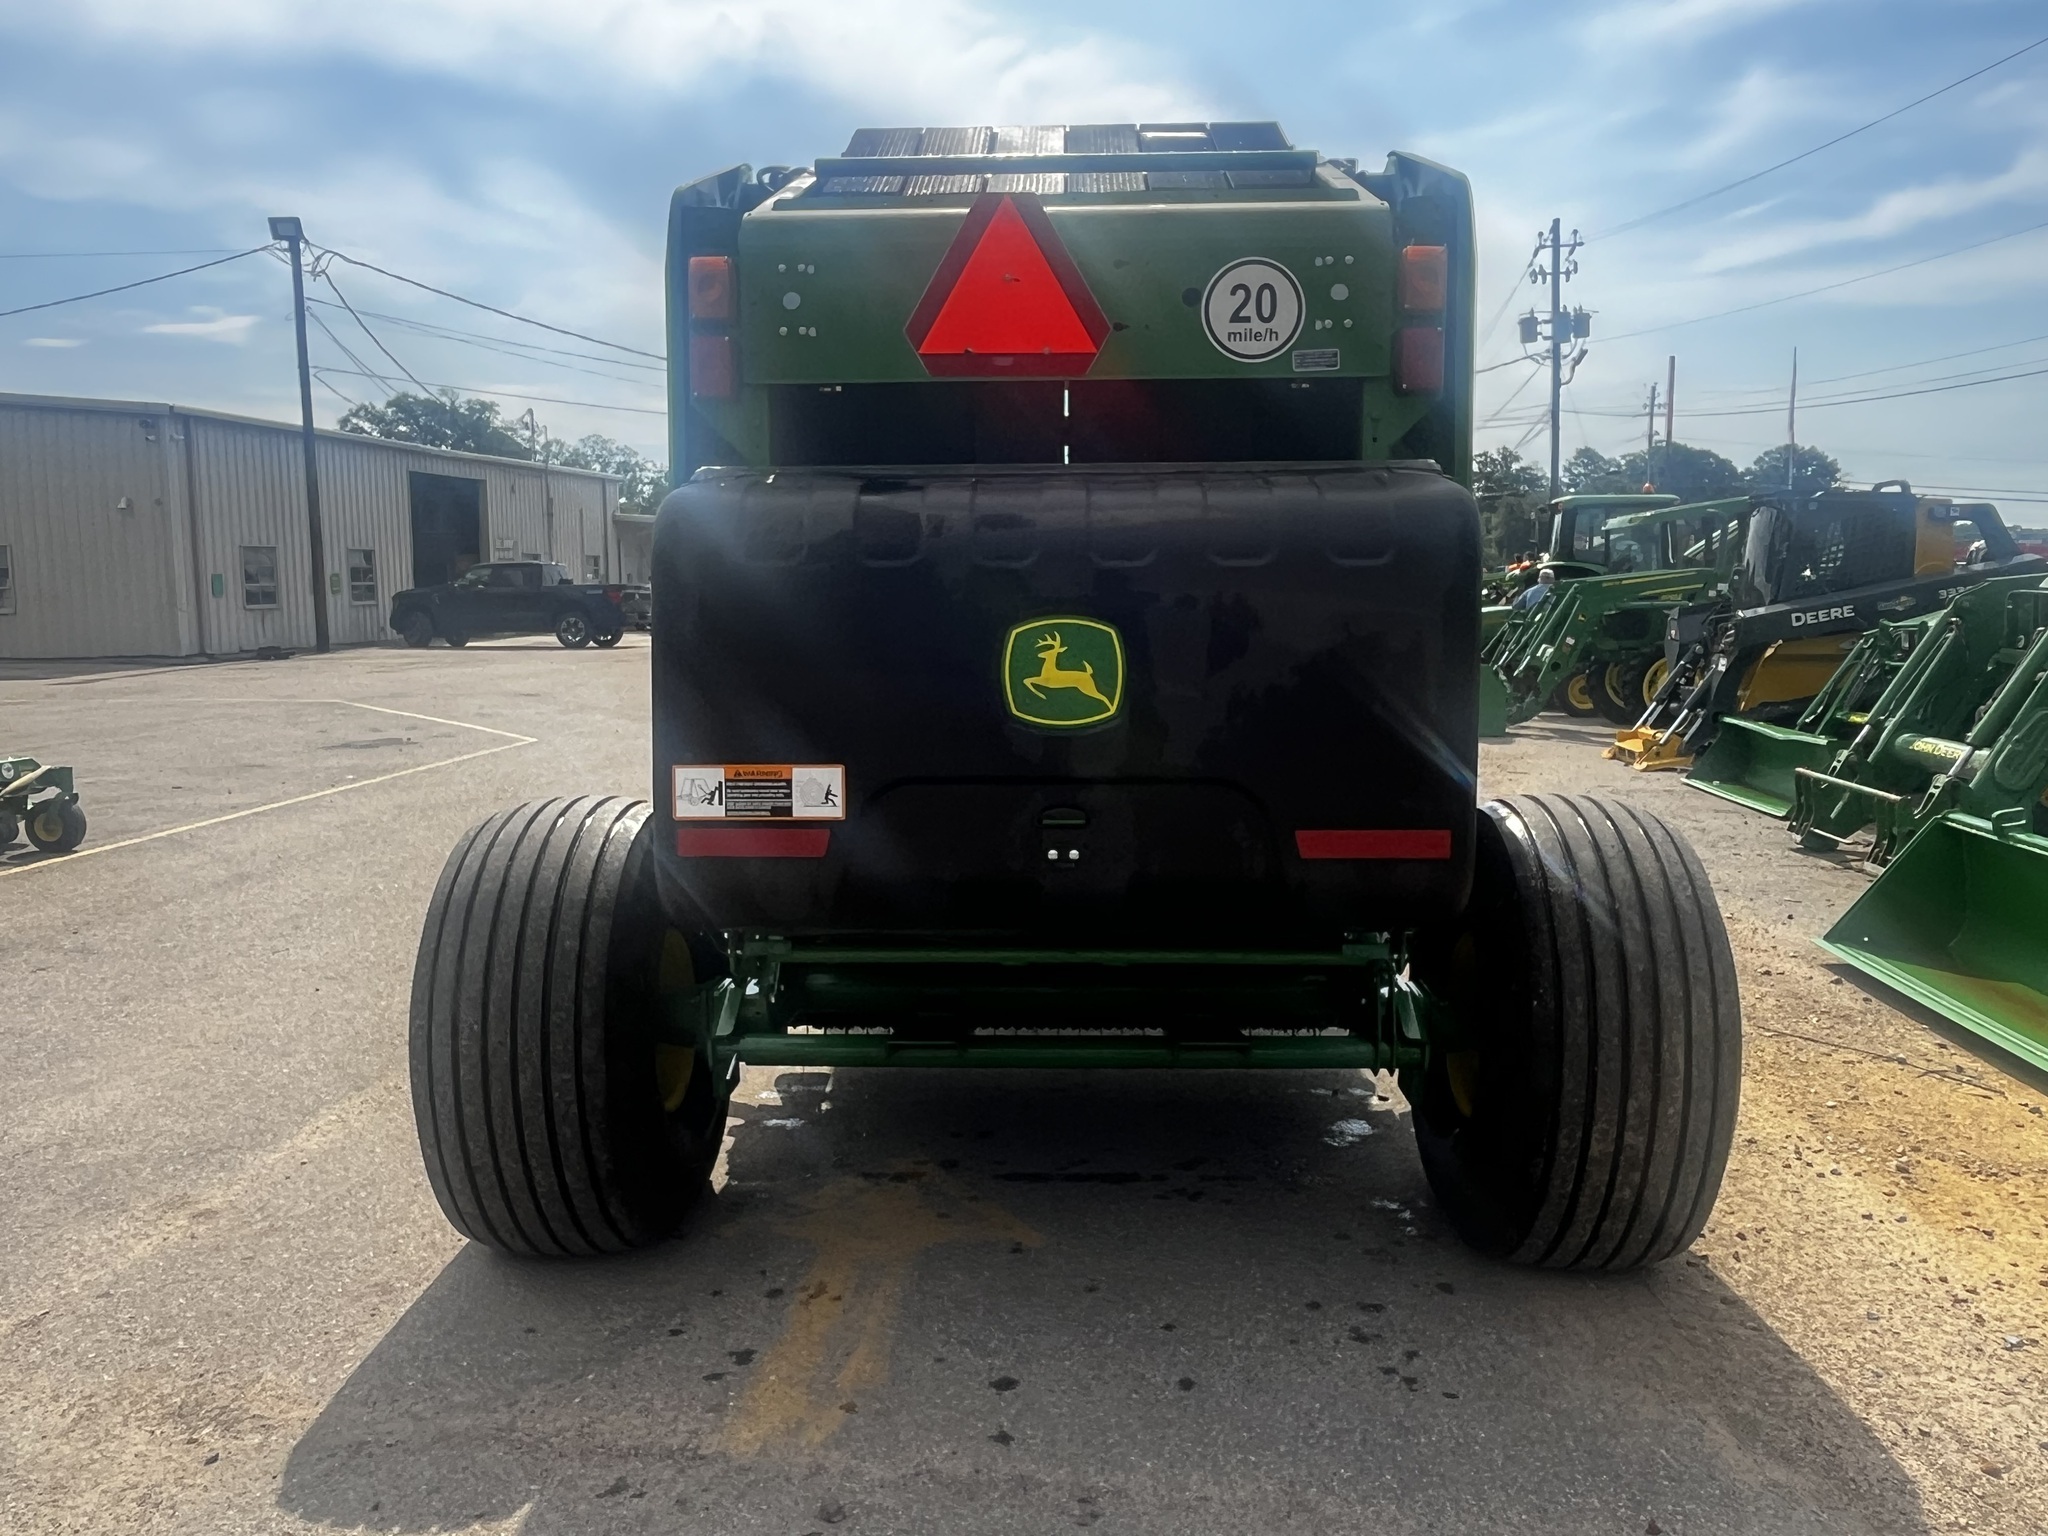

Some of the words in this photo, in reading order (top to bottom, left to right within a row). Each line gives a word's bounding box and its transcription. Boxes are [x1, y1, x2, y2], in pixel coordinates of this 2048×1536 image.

[1229, 283, 1277, 323] 20
[1227, 328, 1279, 343] mile/h
[1791, 605, 1855, 627] DEERE
[1934, 744, 1962, 760] DEER
